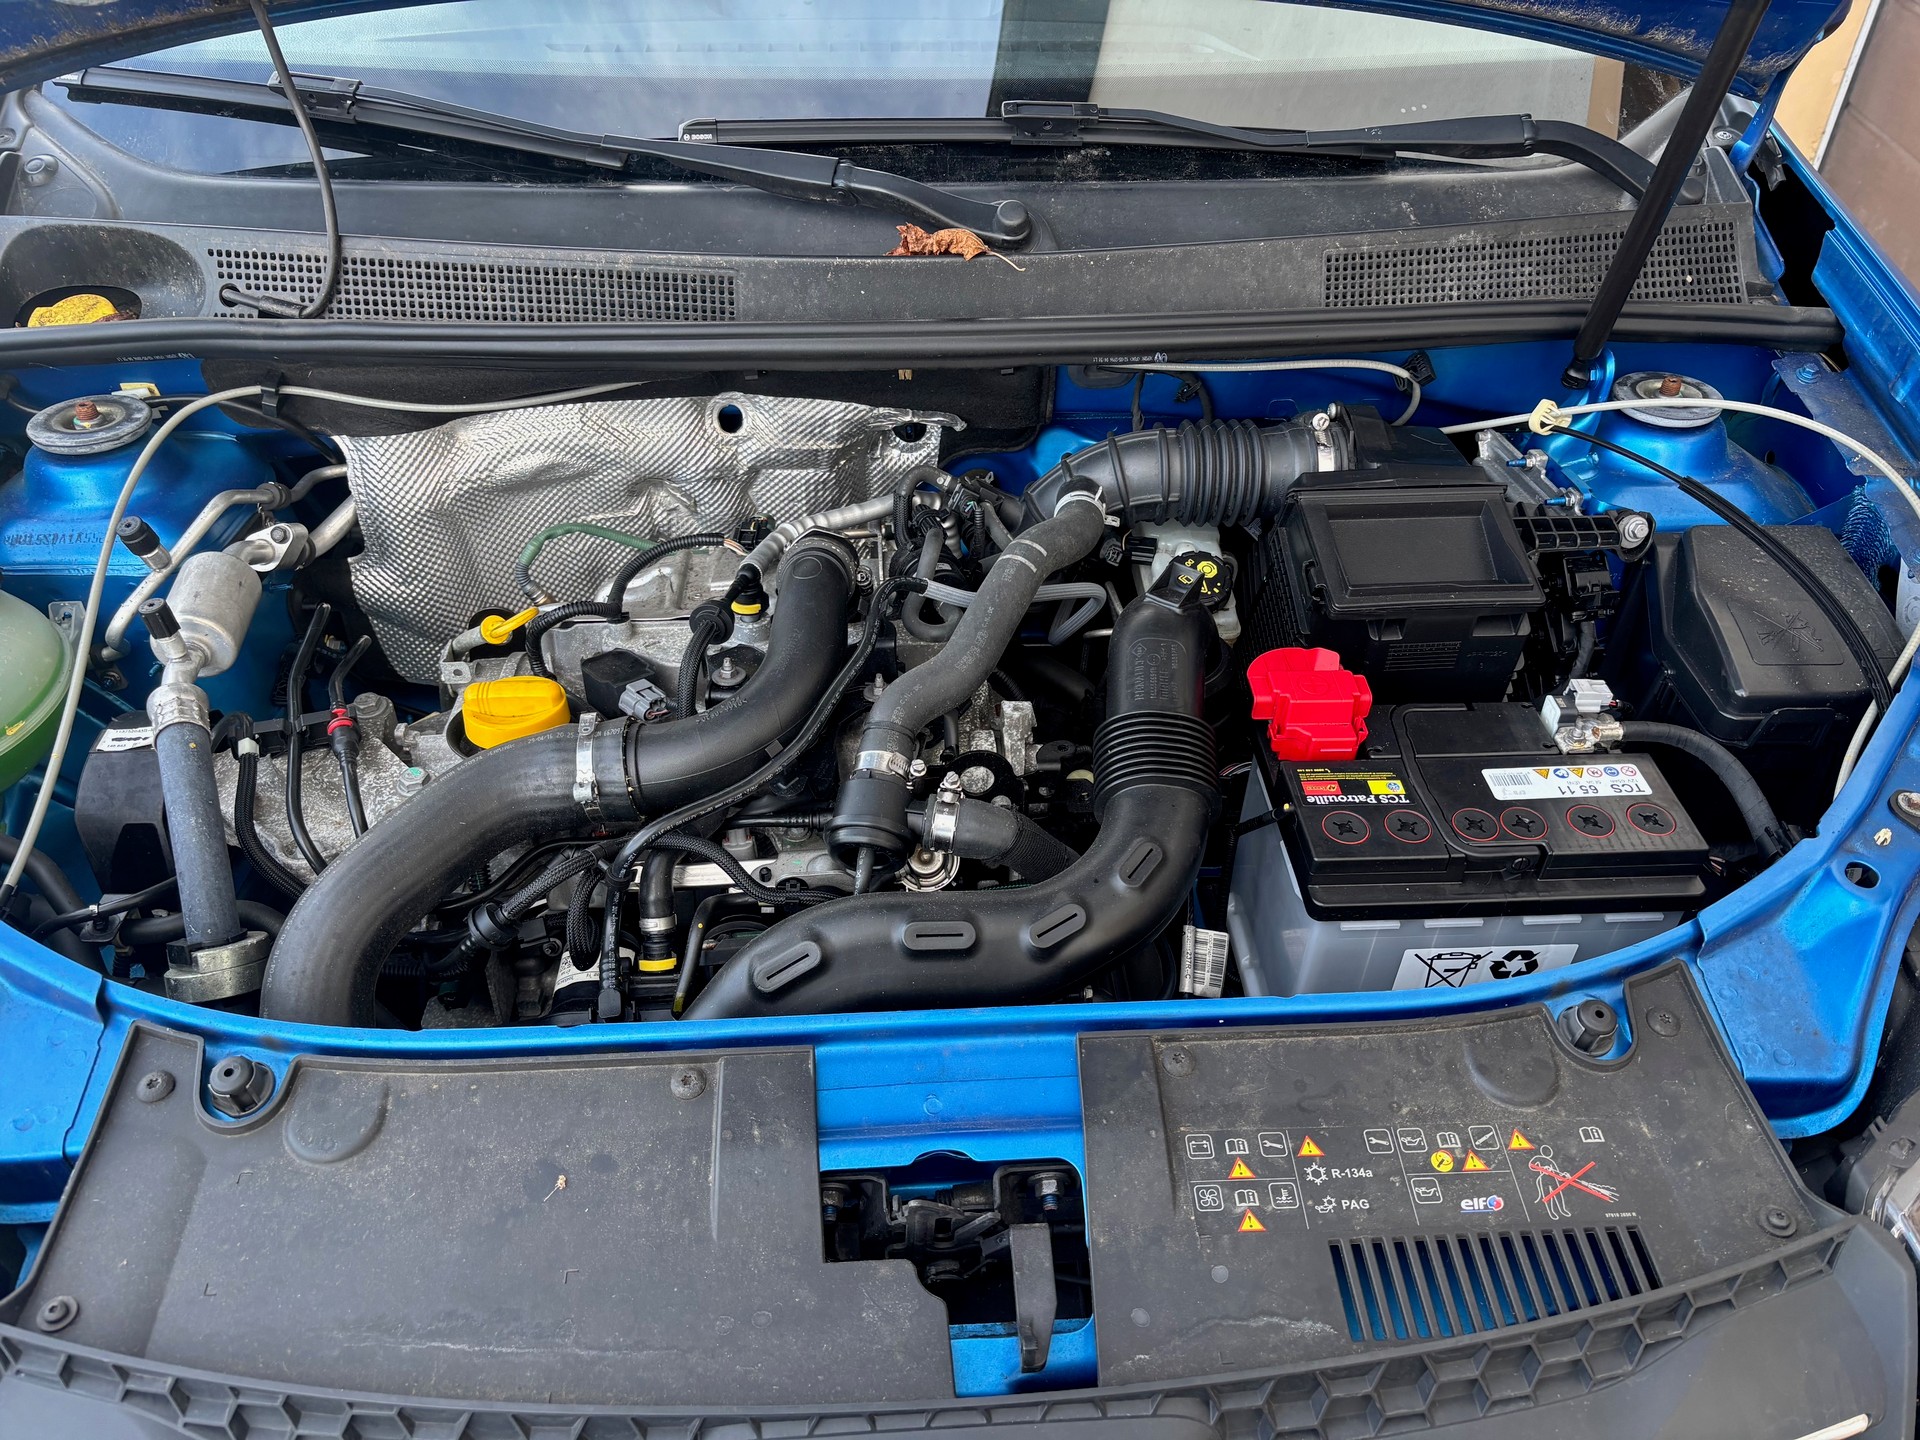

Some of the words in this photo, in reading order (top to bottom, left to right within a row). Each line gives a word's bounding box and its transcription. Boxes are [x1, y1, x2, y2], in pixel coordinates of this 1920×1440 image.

[1557, 785, 1576, 796] 11
[1579, 784, 1599, 794] 65
[1610, 783, 1645, 794] TCS
[1306, 794, 1377, 805] Patrouille
[1379, 794, 1410, 804] TCS
[1331, 1167, 1373, 1179] R-134a
[1341, 1199, 1370, 1210] PAG
[1461, 1195, 1488, 1210] elf
